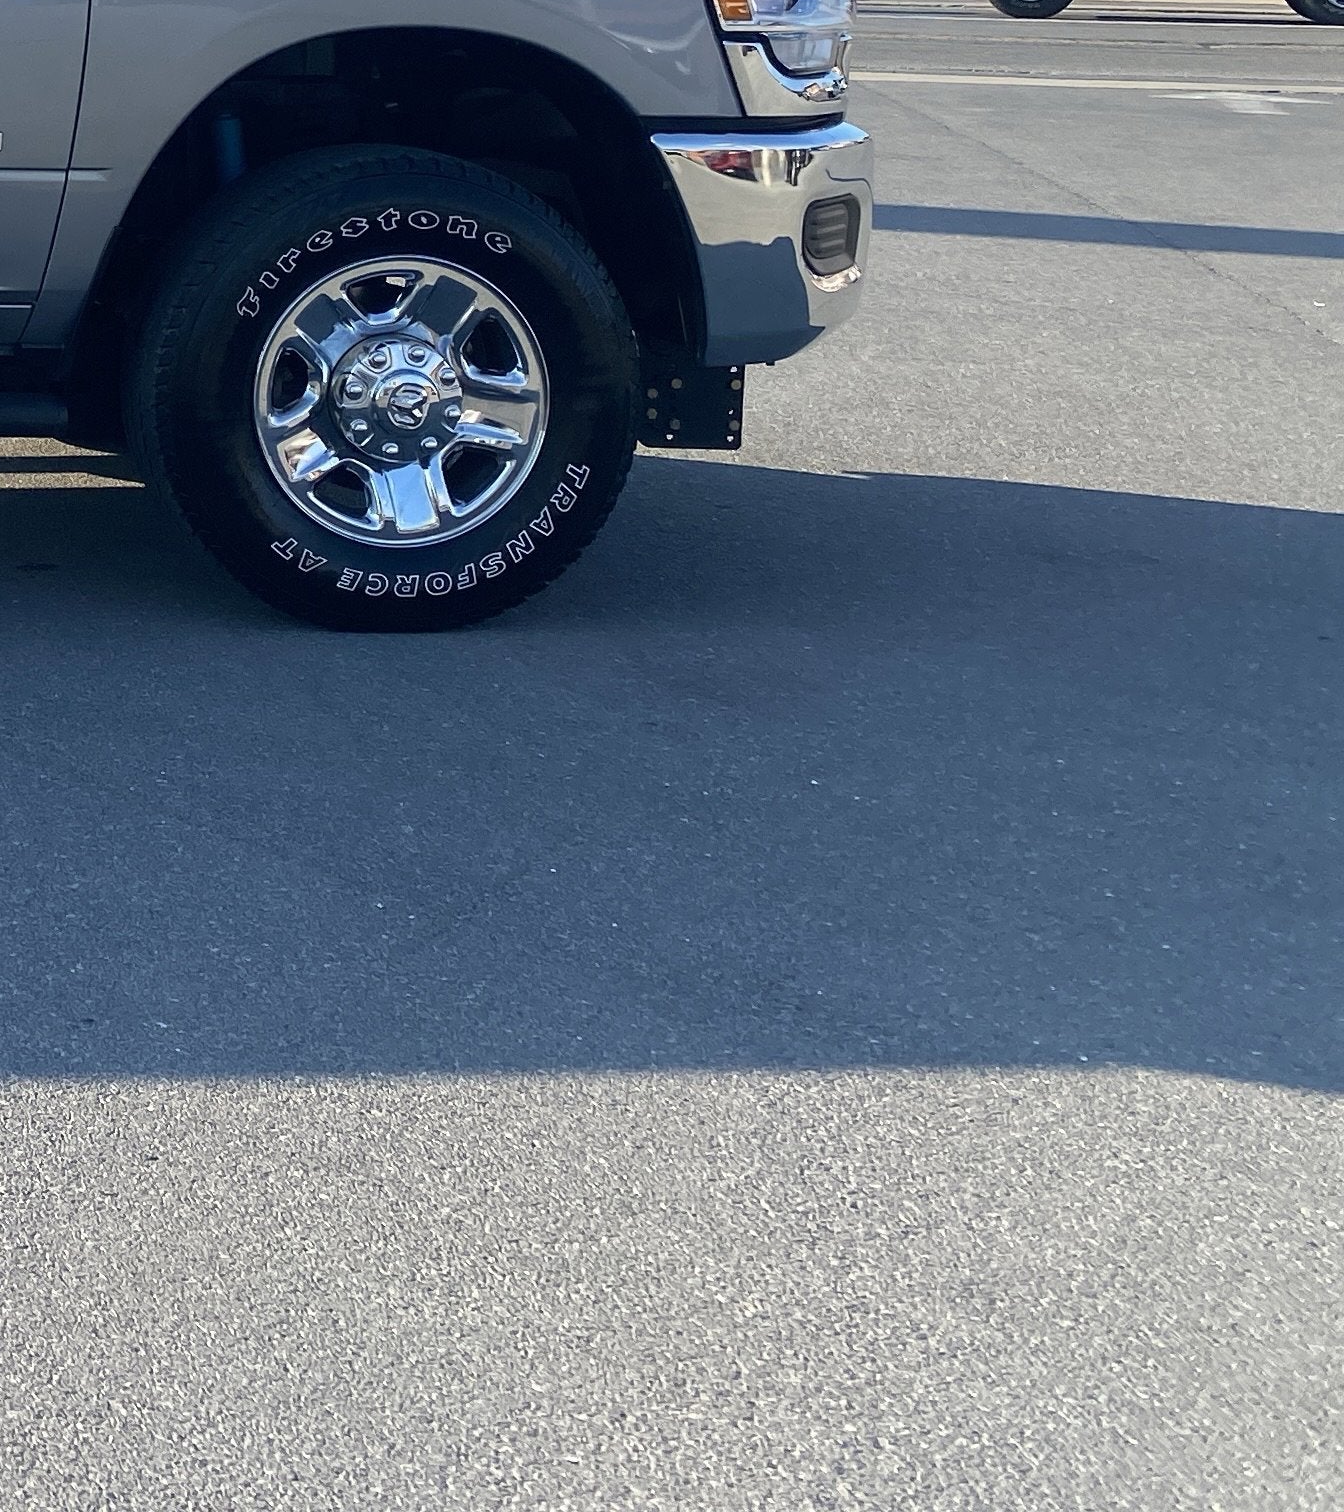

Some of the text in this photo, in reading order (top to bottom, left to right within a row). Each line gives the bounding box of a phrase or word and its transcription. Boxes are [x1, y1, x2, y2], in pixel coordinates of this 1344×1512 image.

[236, 206, 513, 319] Firestone
[270, 461, 591, 598] TRANSFORCE AT
